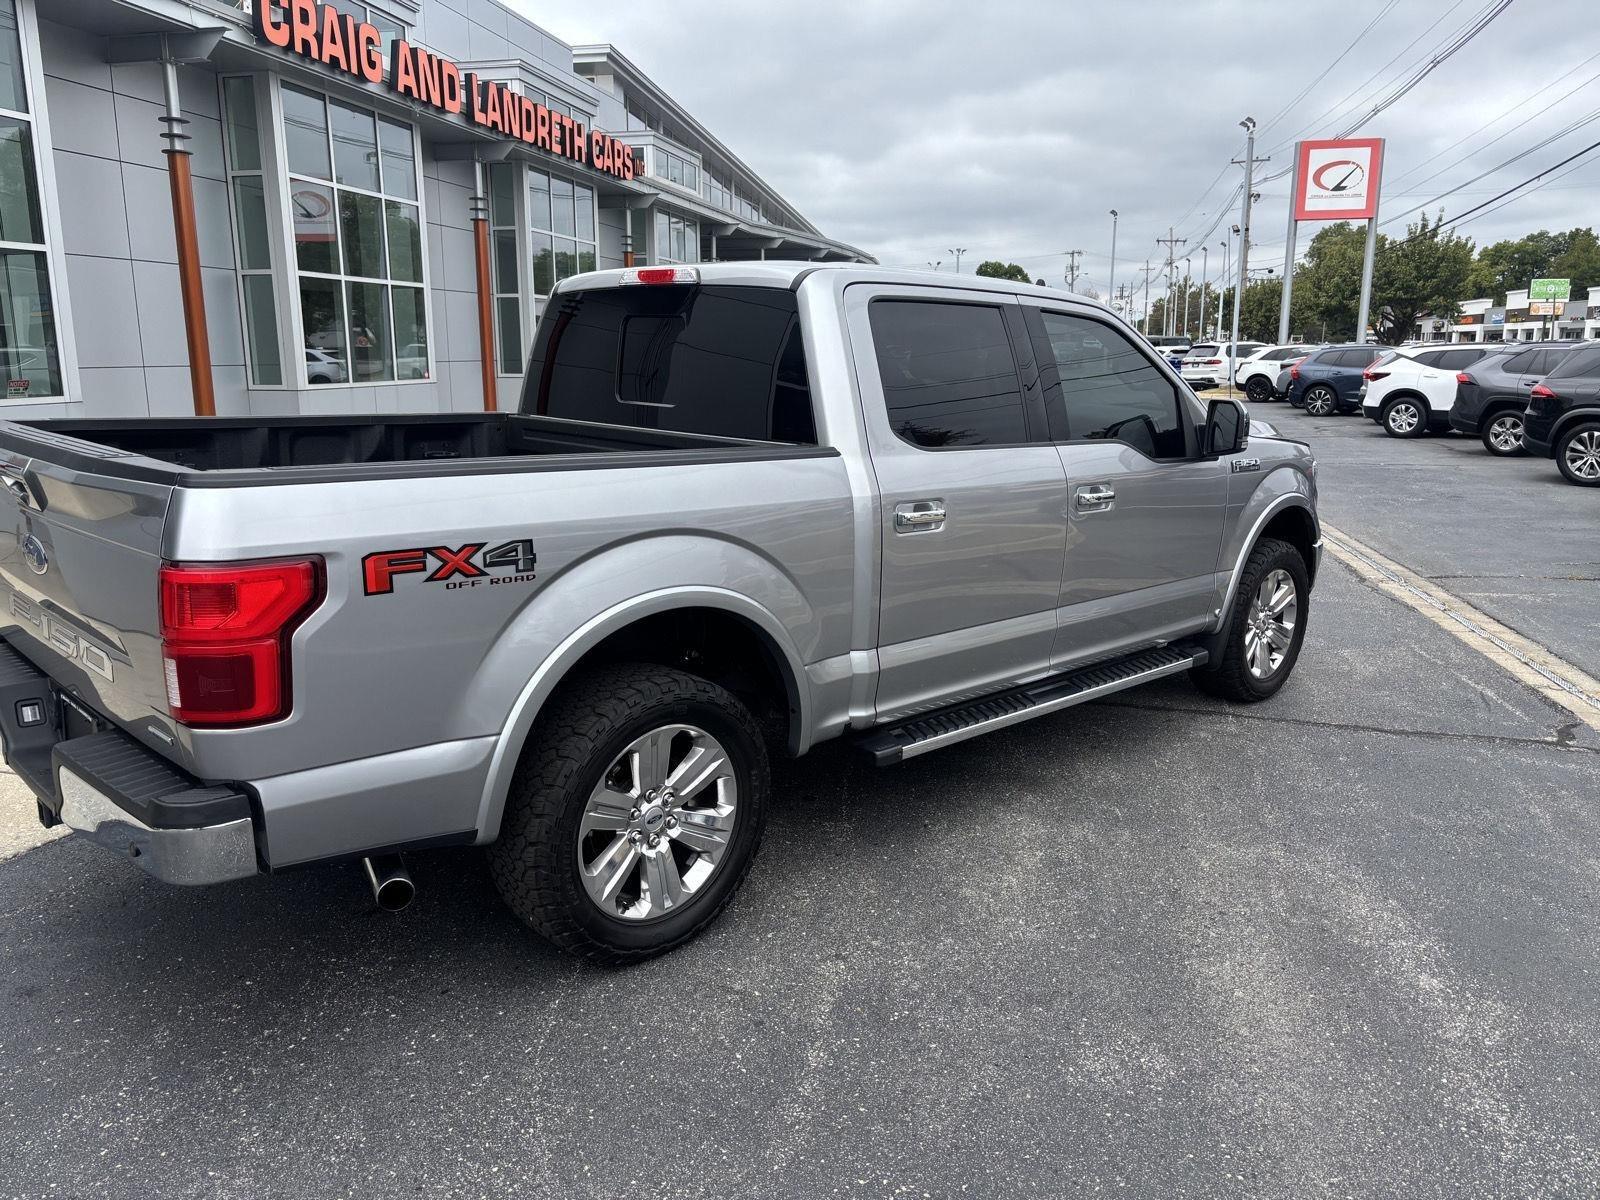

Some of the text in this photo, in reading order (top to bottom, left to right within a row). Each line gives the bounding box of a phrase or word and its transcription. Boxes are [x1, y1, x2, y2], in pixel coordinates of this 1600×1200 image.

[260, 0, 383, 83] CRAIG
[397, 39, 461, 114] AND
[471, 72, 587, 164] LANDRETH
[592, 130, 634, 181] CARS
[361, 538, 537, 597] FX4
[445, 573, 537, 590] OFF ROAD
